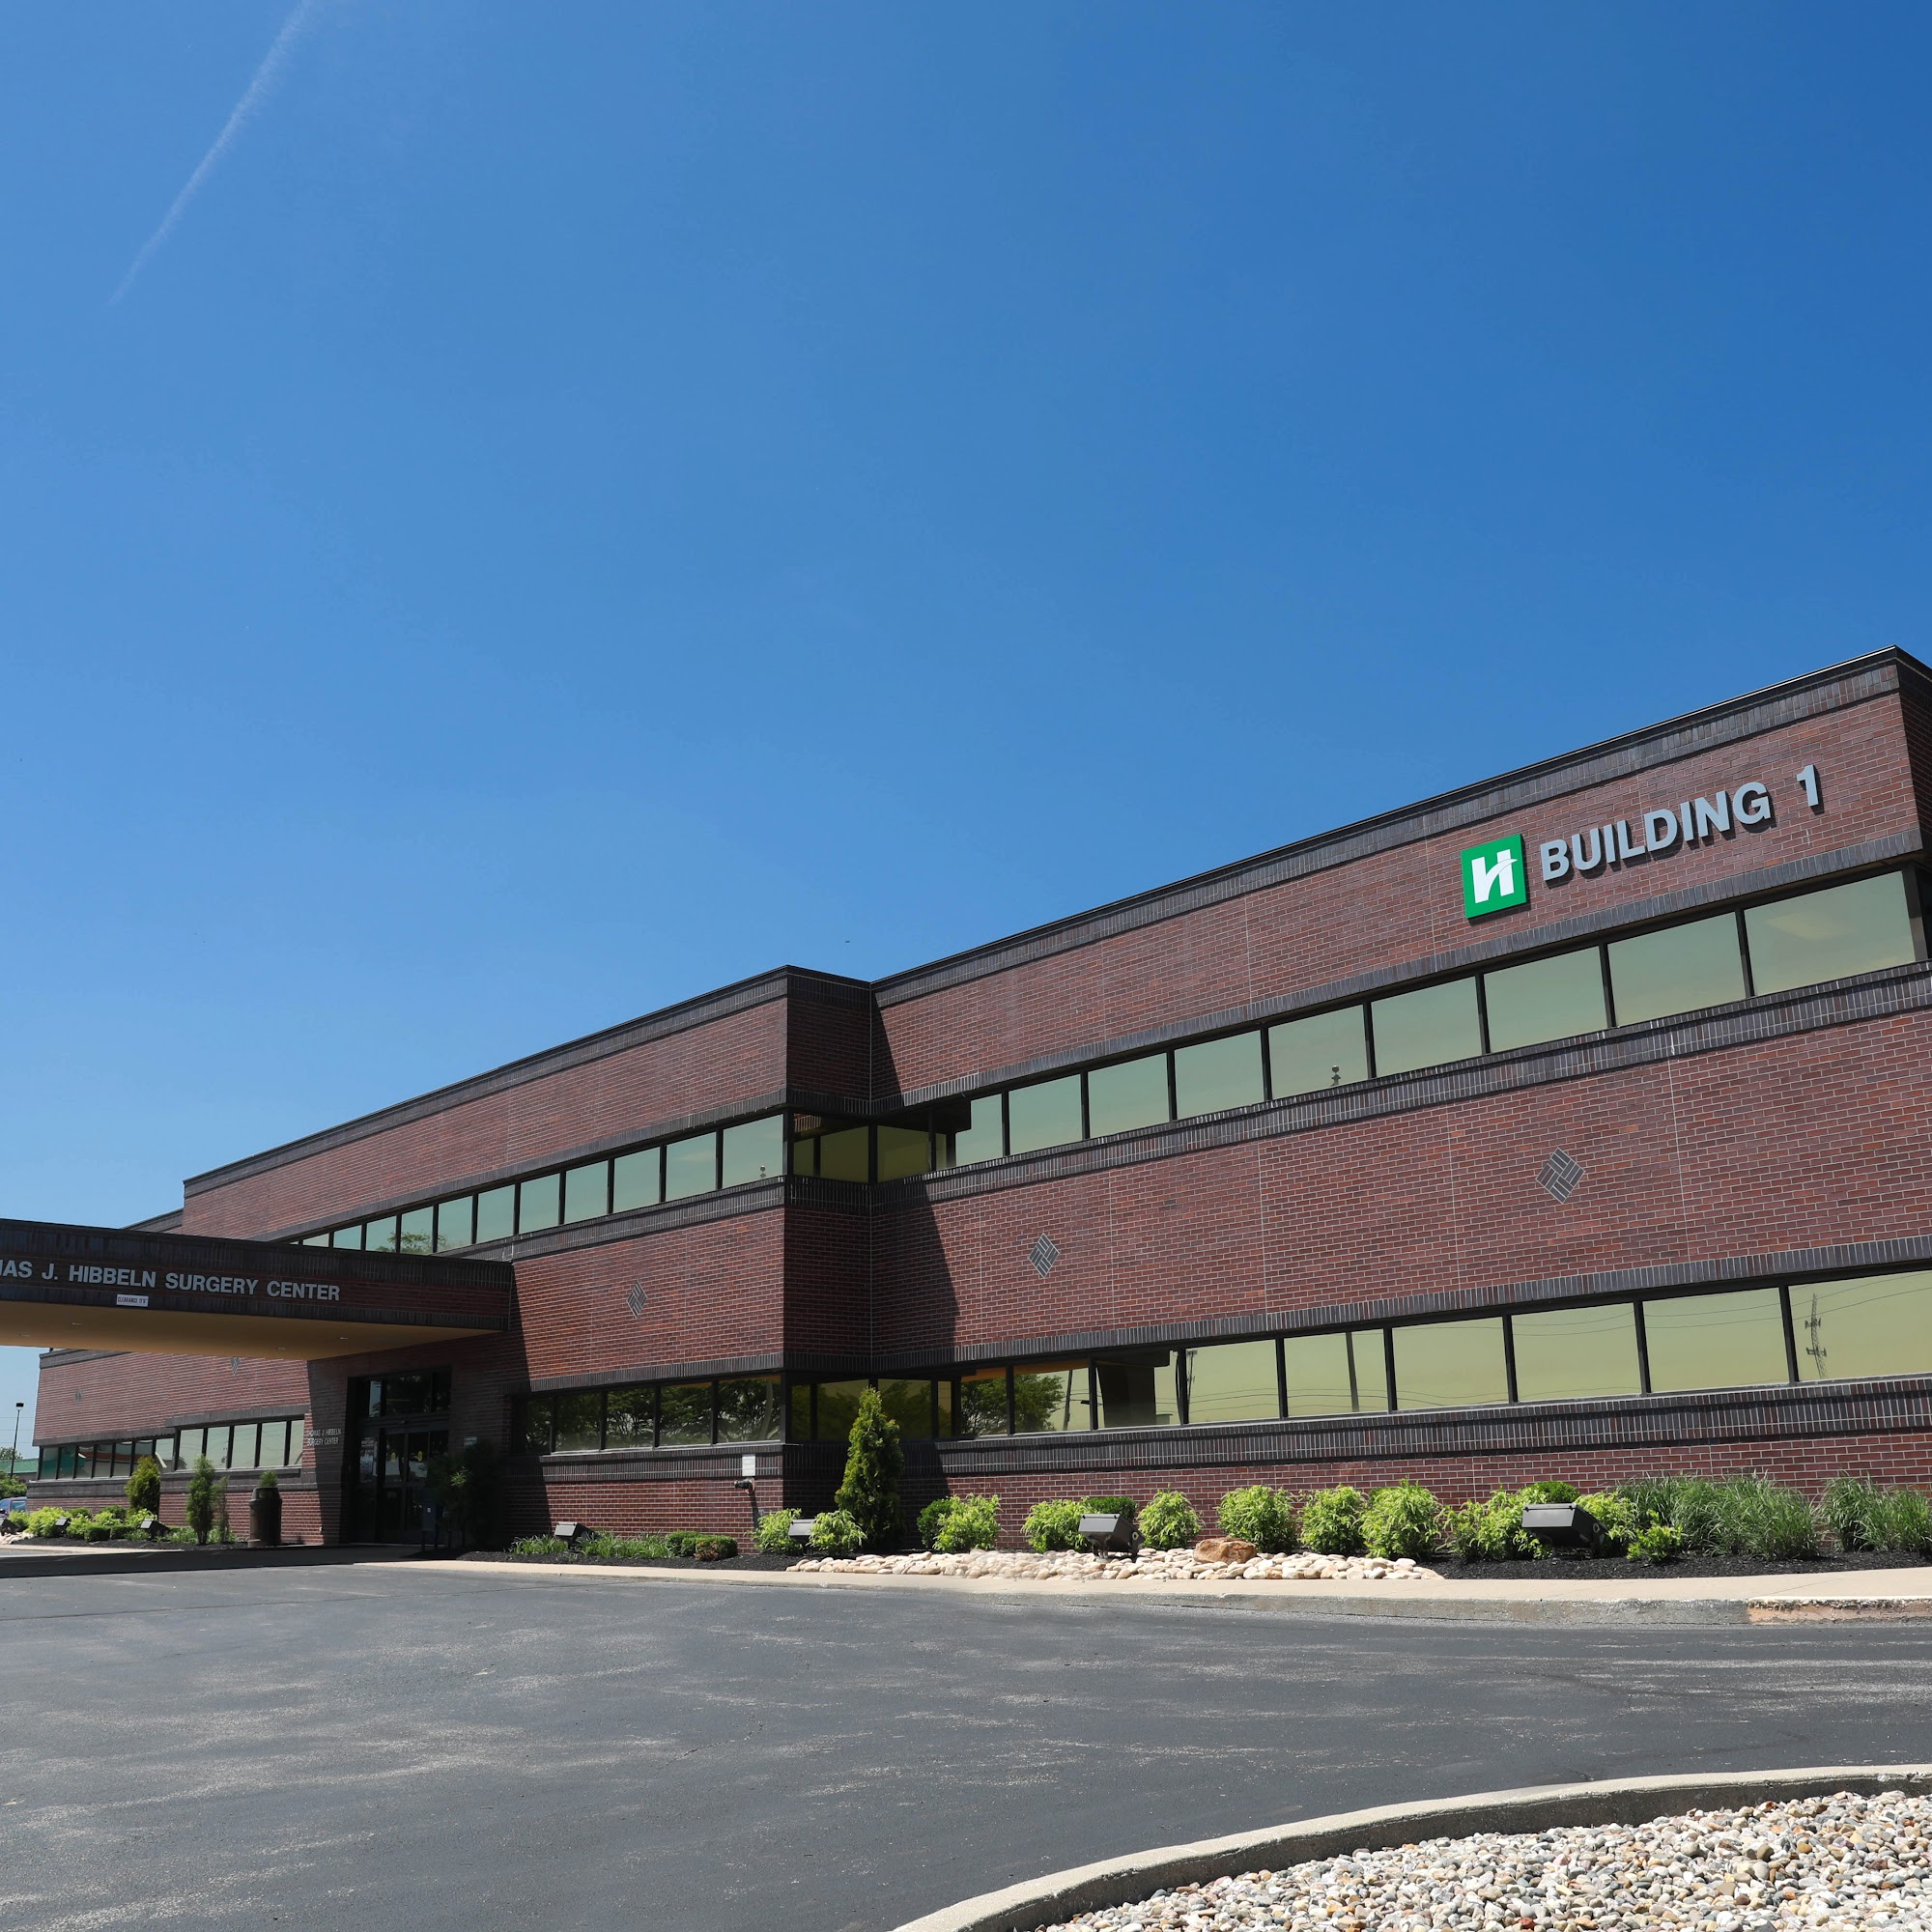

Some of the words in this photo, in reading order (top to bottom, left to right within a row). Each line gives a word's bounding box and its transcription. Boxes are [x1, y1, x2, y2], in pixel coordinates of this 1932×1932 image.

[1539, 781, 1772, 882] BUILDING
[1796, 763, 1820, 807] 1
[42, 1263, 59, 1281] J.
[69, 1264, 156, 1288] HIBBELN
[165, 1272, 259, 1295] SURGERY
[267, 1280, 341, 1301] CENTER
[324, 1436, 339, 1445] CENTER
